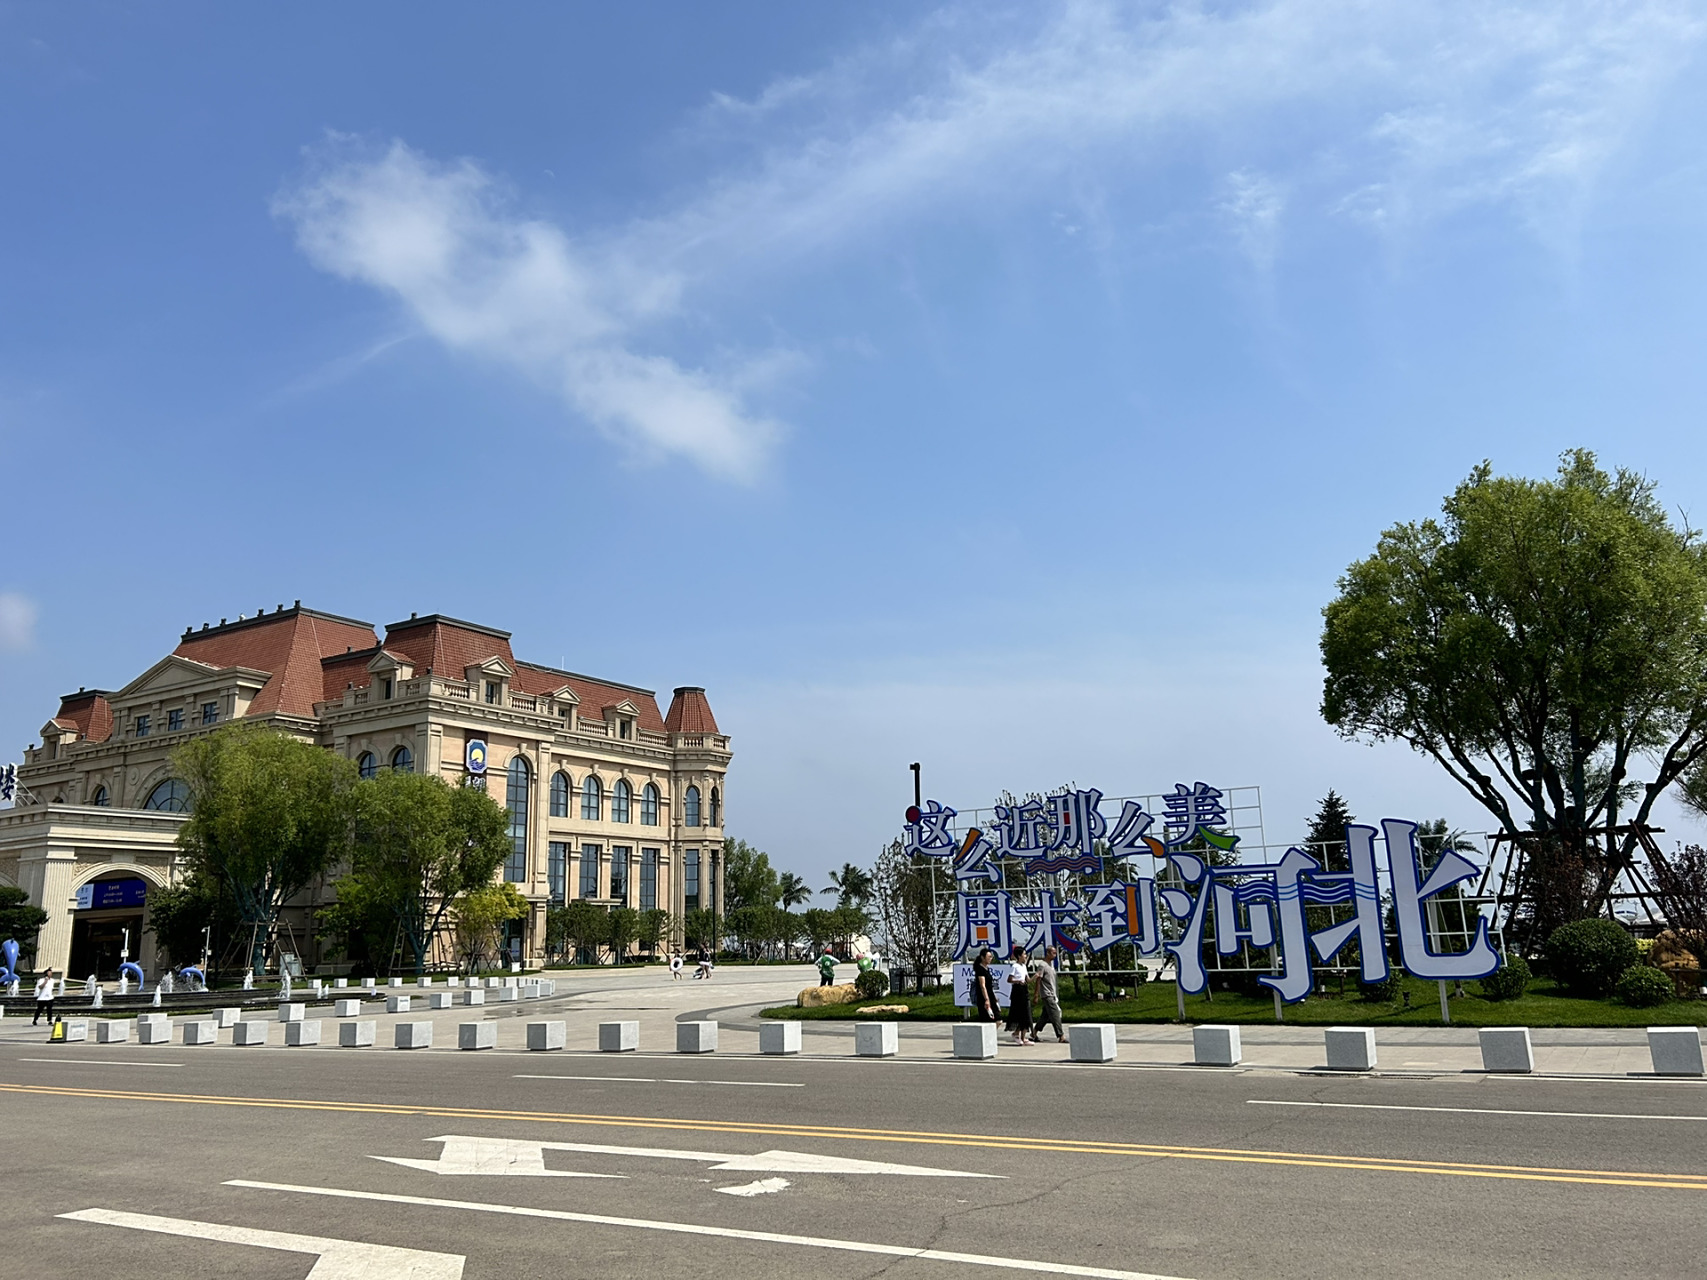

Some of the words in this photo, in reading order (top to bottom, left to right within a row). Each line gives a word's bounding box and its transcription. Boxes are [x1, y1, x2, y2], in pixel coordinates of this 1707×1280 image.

[904, 781, 1240, 882] 这么近那么美
